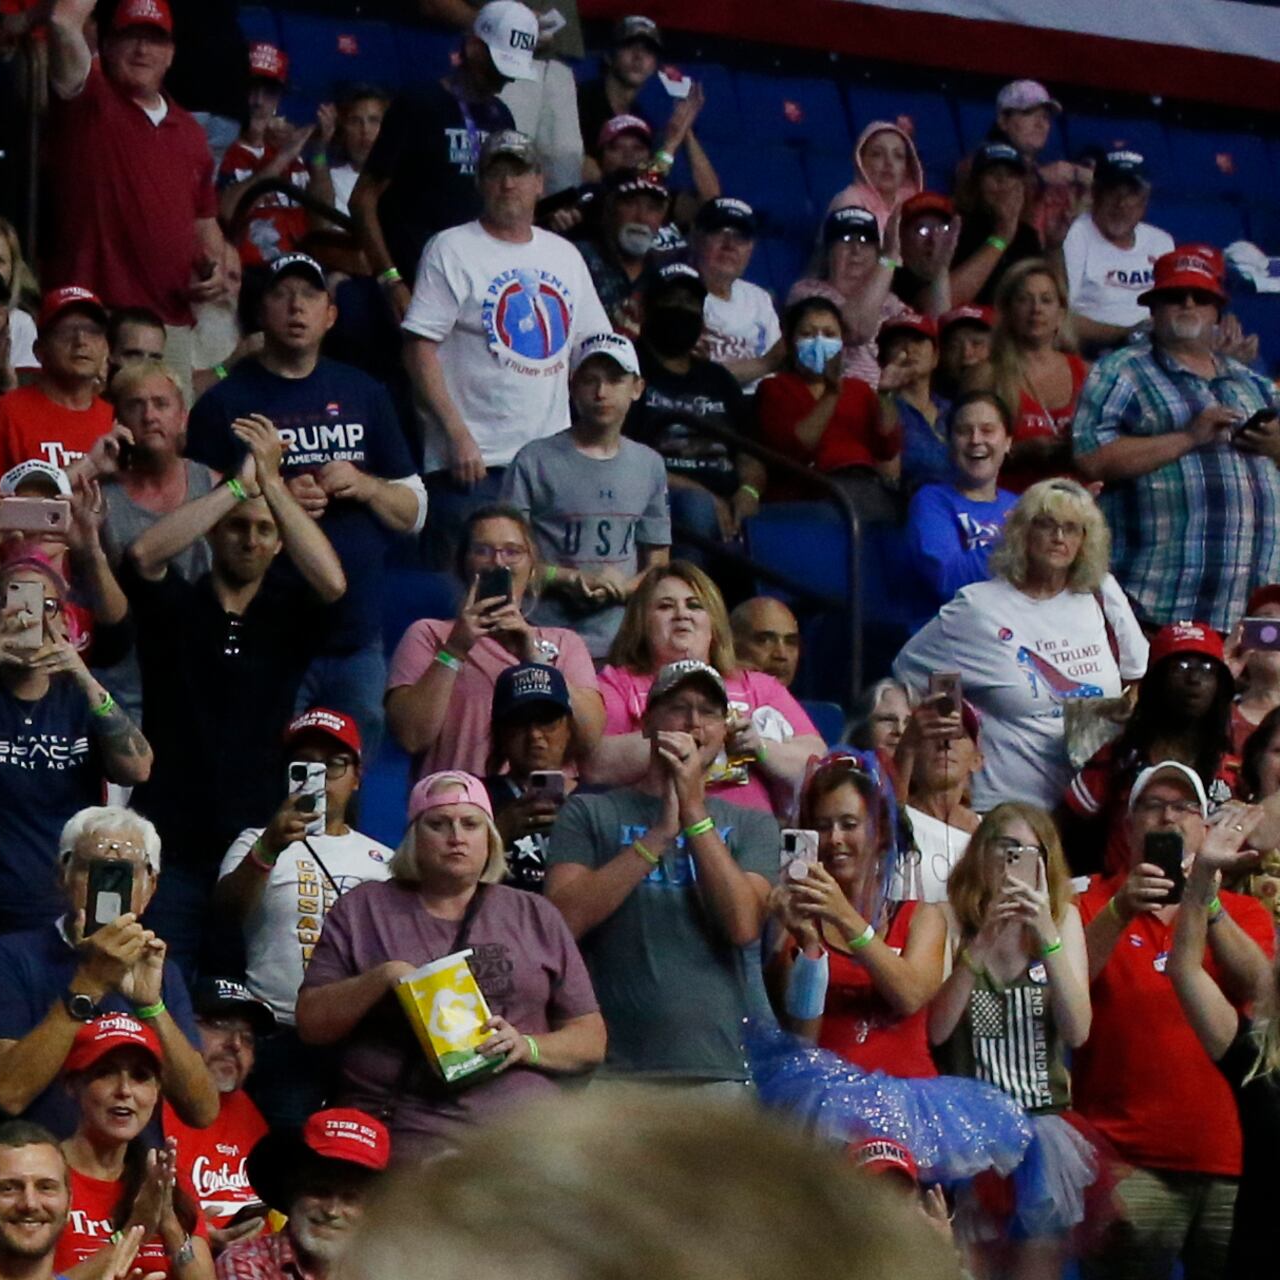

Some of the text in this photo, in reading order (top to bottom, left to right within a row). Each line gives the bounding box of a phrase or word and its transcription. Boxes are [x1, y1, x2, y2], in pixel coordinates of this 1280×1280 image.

[581, 334, 626, 350] TRUMP
[286, 451, 364, 466] AMERICA GREAT!
[561, 518, 634, 557] USA
[1052, 643, 1102, 666] TRUMP
[1068, 659, 1103, 676] GIRL
[1032, 1021, 1052, 1106] AMENDMENT
[326, 1120, 359, 1134] TRUMP
